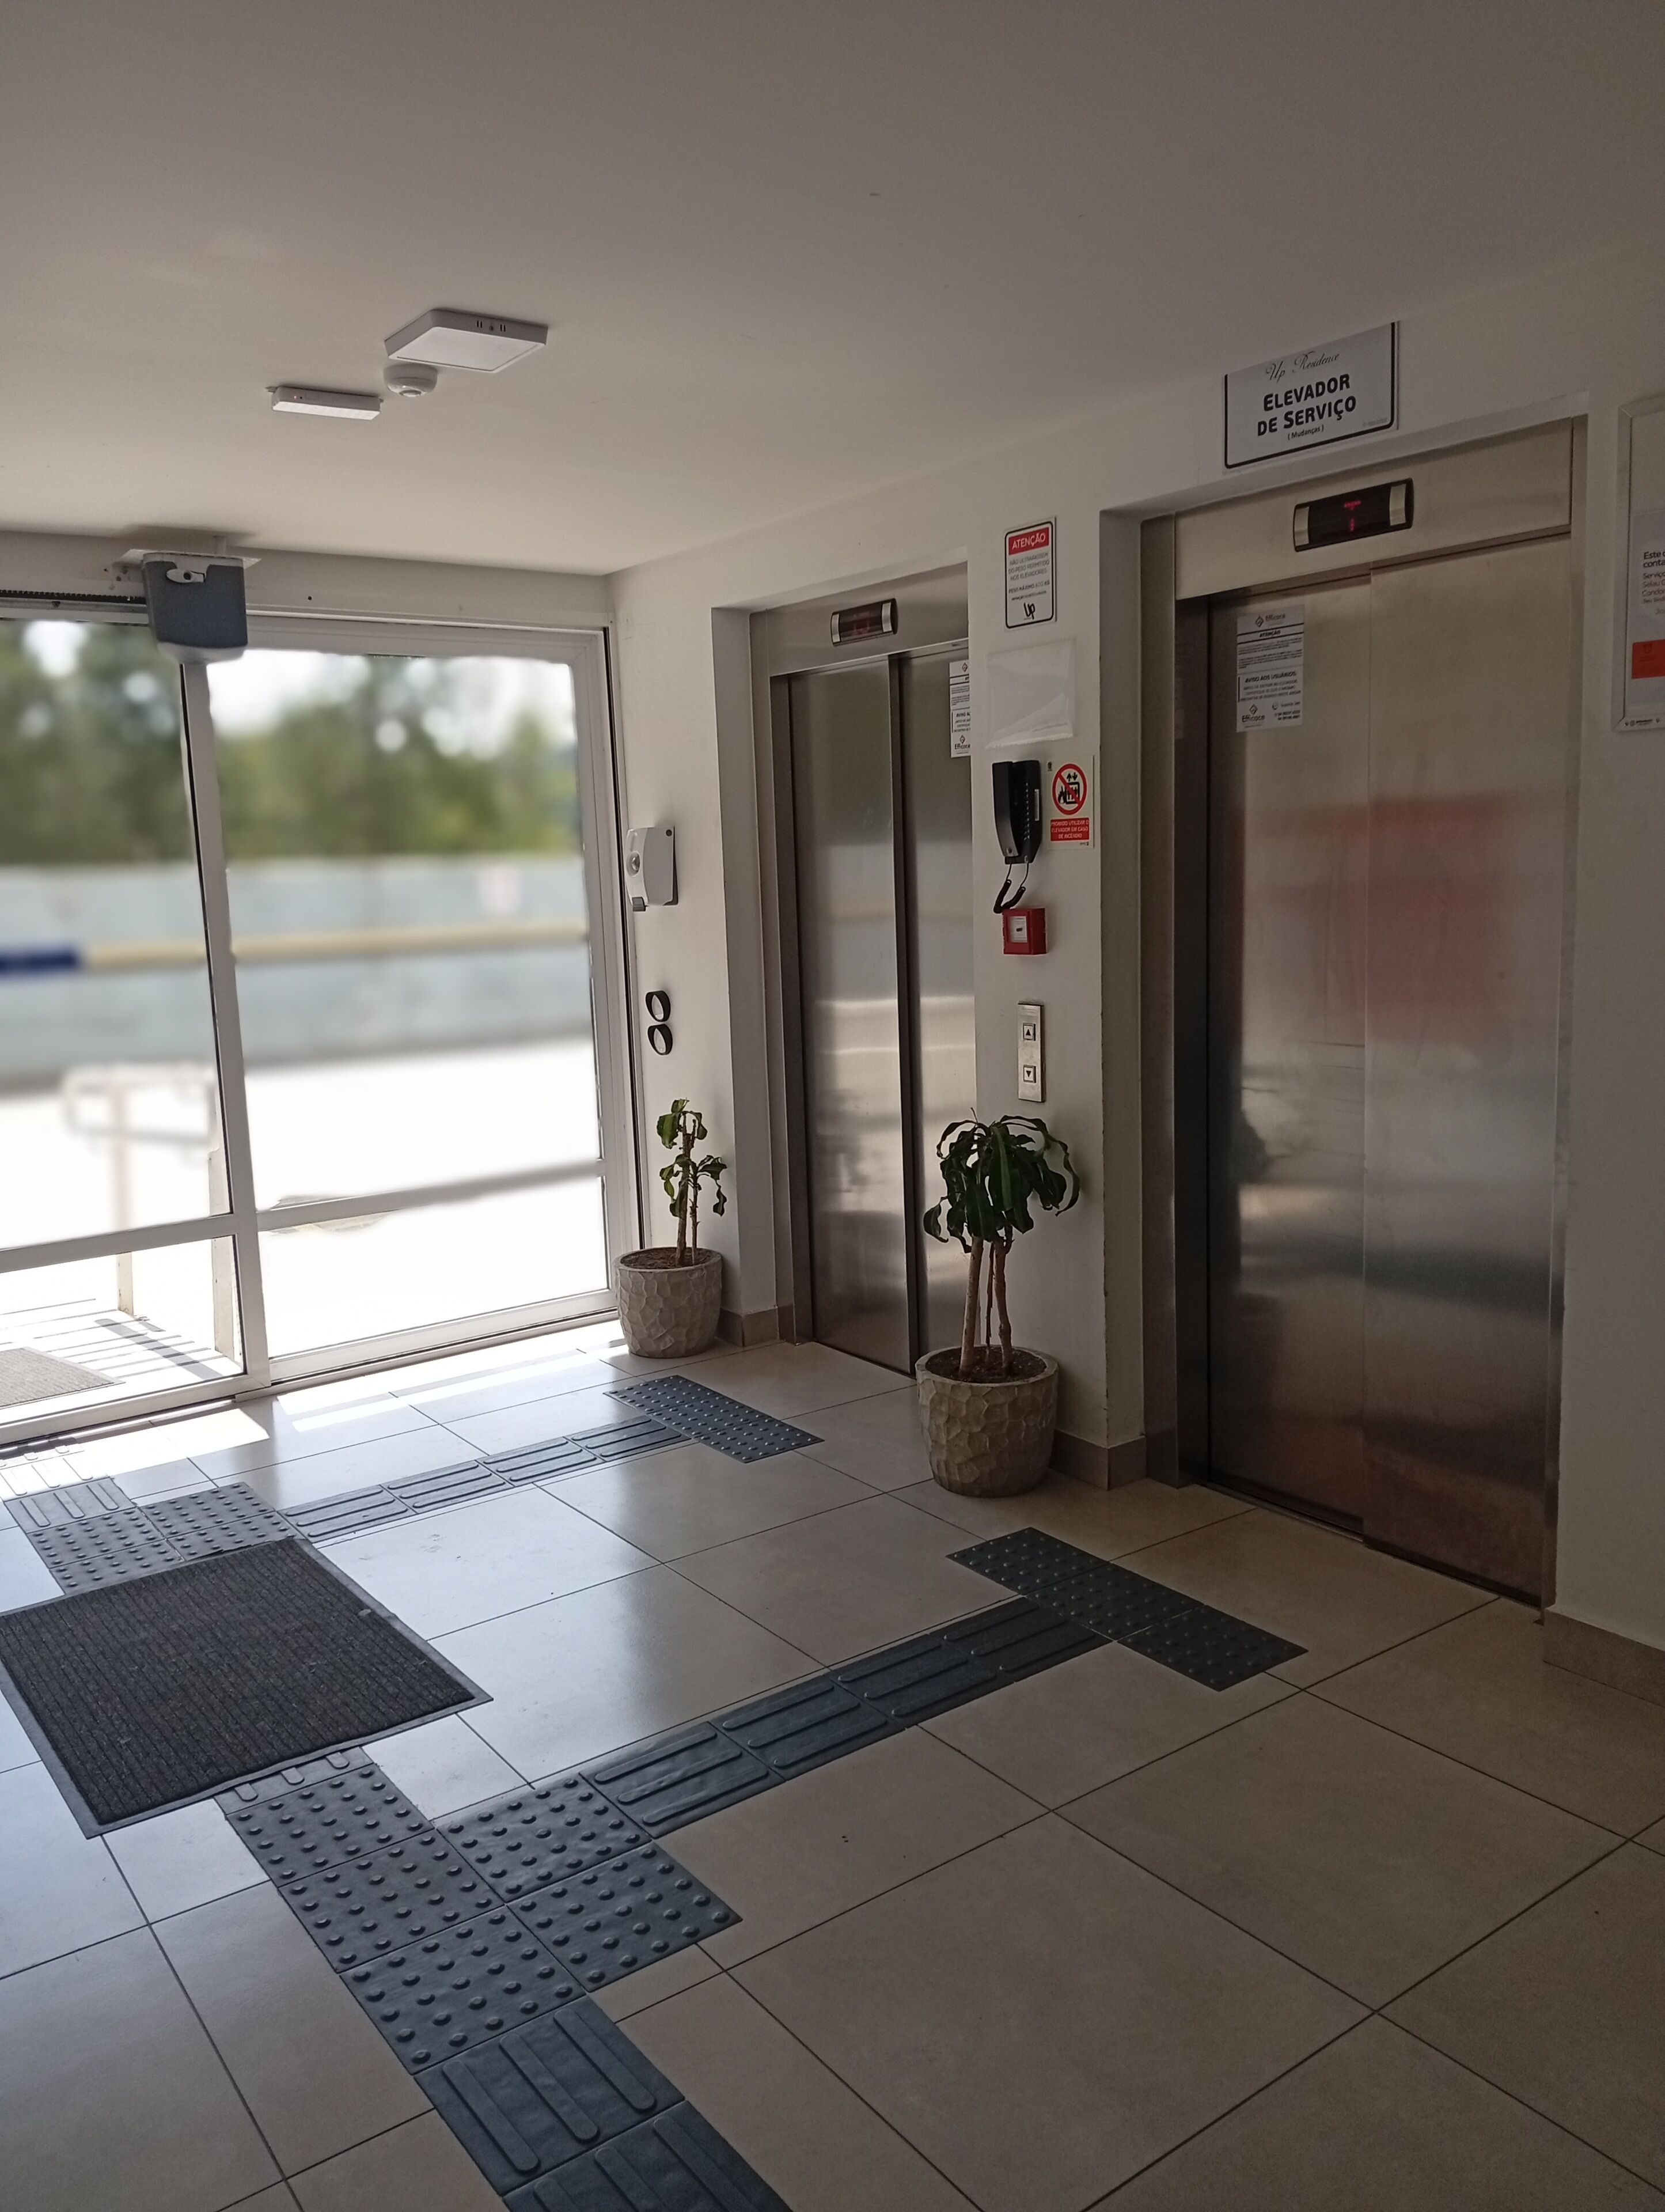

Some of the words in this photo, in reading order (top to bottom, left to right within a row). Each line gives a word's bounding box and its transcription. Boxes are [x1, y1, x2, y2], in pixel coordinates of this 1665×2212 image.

[1264, 374, 1351, 411] ELEVADOR
[1258, 417, 1277, 436] DE
[1284, 396, 1356, 429] SERVIÇO
[1012, 532, 1046, 550] ATENÇÃO
[1644, 551, 1662, 560] Este
